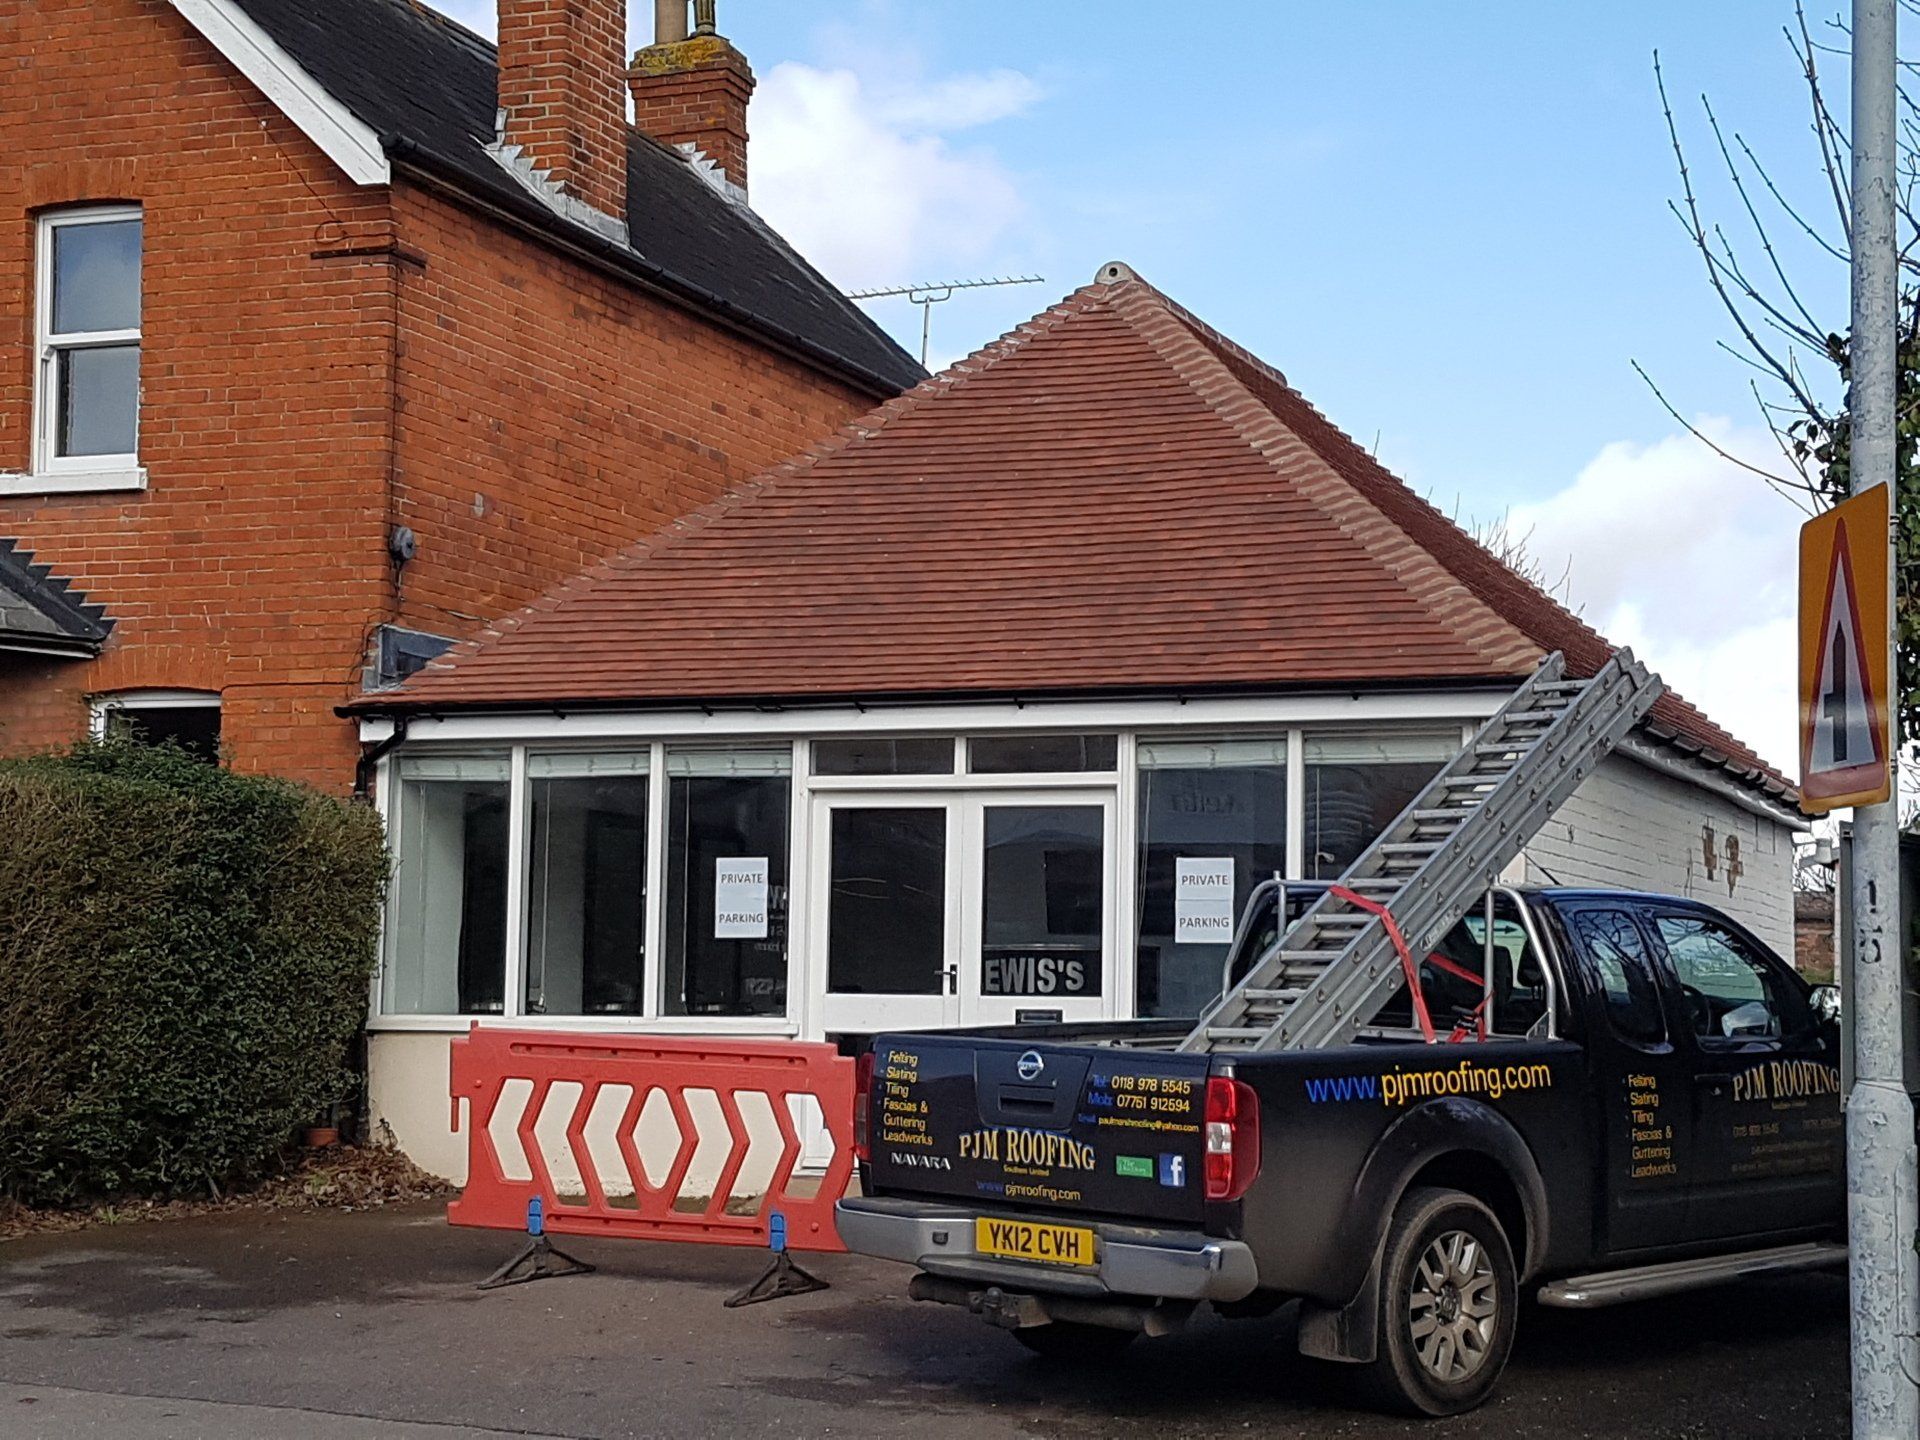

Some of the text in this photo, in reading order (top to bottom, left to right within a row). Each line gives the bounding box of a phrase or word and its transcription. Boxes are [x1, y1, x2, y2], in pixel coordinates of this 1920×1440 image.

[721, 873, 763, 884] PRIVATE
[1181, 875, 1228, 885] PRIVATE
[719, 913, 764, 923] PARKING
[1179, 917, 1230, 928] PARKING
[886, 1066, 918, 1083] Slating
[1733, 1059, 1840, 1101] PJM ROOFING
[1111, 1075, 1134, 1090] 0118
[1137, 1077, 1158, 1092] 978
[1161, 1079, 1191, 1094] 5545
[883, 1098, 929, 1113] Fascias &
[883, 1113, 926, 1131] Guttering
[883, 1129, 933, 1146] Leadworks
[1665, 1125, 1673, 1139] &
[959, 1128, 1096, 1170] PJM ROOFING
[1631, 1146, 1671, 1160] Guttering
[891, 1152, 951, 1170] NAVARA
[989, 1222, 1079, 1258] YK12 CVH
